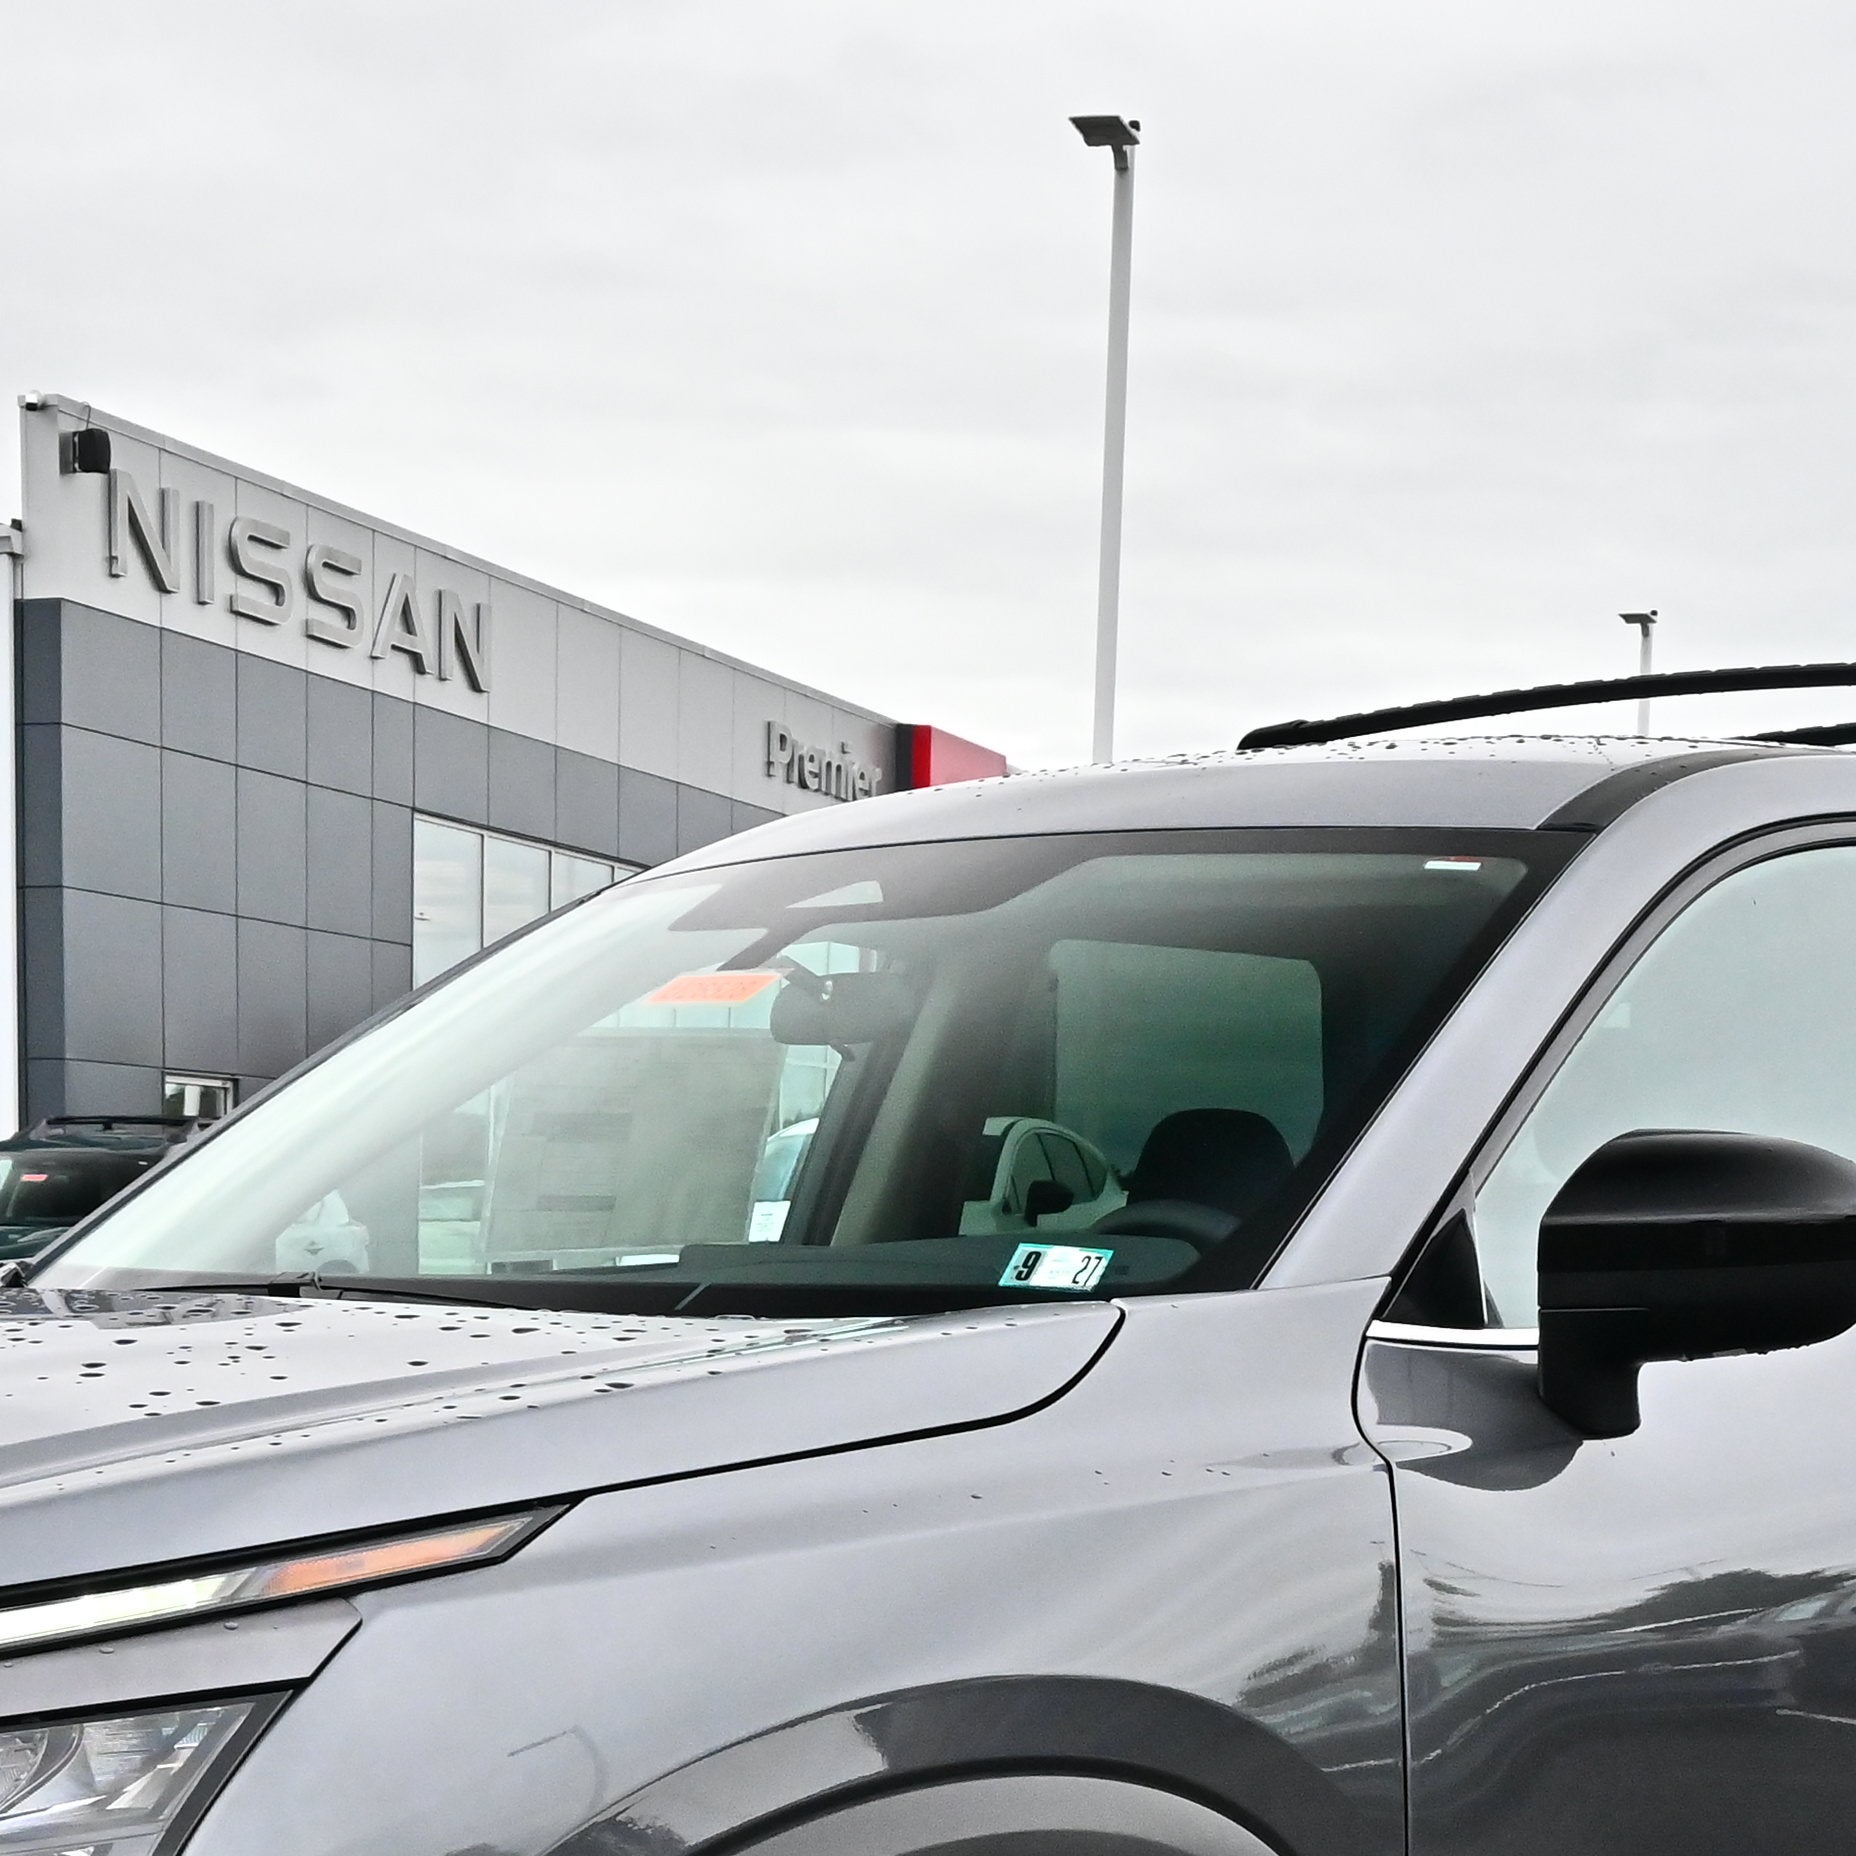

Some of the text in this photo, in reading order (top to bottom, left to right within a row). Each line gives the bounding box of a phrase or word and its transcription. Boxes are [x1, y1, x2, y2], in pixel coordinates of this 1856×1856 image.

[108, 468, 493, 693] NISSAN
[766, 720, 883, 802] Premier
[1014, 1251, 1104, 1287] 9 27
